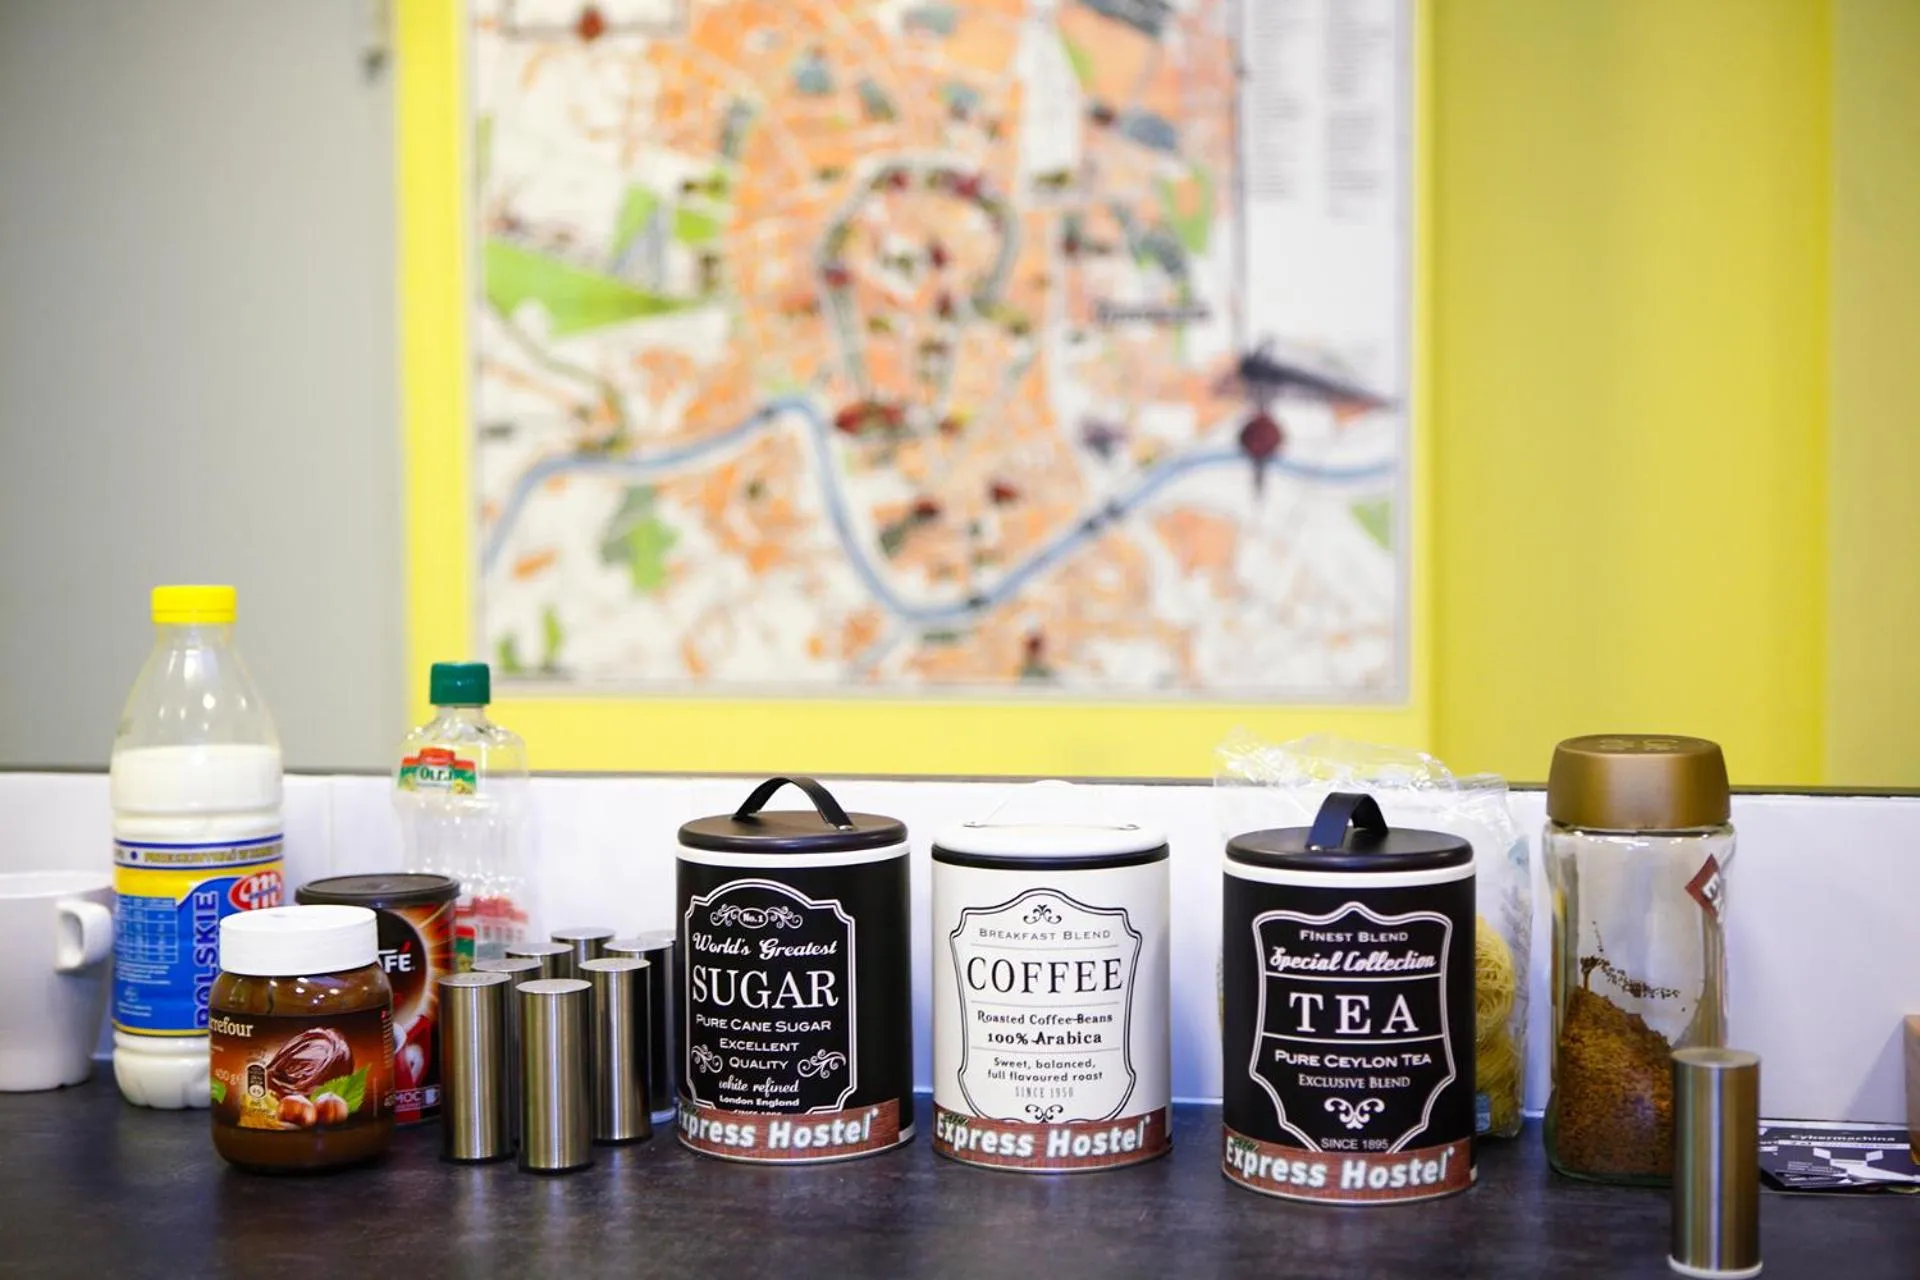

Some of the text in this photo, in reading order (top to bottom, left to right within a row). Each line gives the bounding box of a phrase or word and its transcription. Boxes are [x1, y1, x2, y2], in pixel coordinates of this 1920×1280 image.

[979, 927, 1111, 941] BREAKFAST BLEND
[1299, 929, 1409, 943] FINEST BLEND
[692, 932, 838, 960] World's Greatest
[1270, 946, 1436, 972] Special Collection
[967, 956, 1124, 994] COFFEE
[692, 964, 838, 1009] SUGAR
[977, 1010, 1025, 1026] Roasted
[1289, 991, 1419, 1034] TEA
[696, 1014, 832, 1033] PURE CANE SUGAR
[719, 1038, 799, 1052] EXCELLENT
[987, 1032, 1029, 1045] 100%
[729, 1056, 789, 1070] QUALITY
[994, 1057, 1032, 1070] Sweet,
[1274, 1049, 1432, 1068] PURE CEYLON TEA
[987, 1070, 1103, 1083] full flavoured roast
[1298, 1073, 1411, 1089] EXCLUSIVE BLEND
[719, 1075, 800, 1098] white refined
[1015, 1086, 1044, 1099] SINCE
[719, 1095, 800, 1109] London England
[679, 1104, 872, 1150] xpress Hostel
[937, 1111, 1144, 1158] Express Hostel
[1321, 1137, 1389, 1150] SINCE 1895
[1226, 1135, 1447, 1190] Express Hostel
